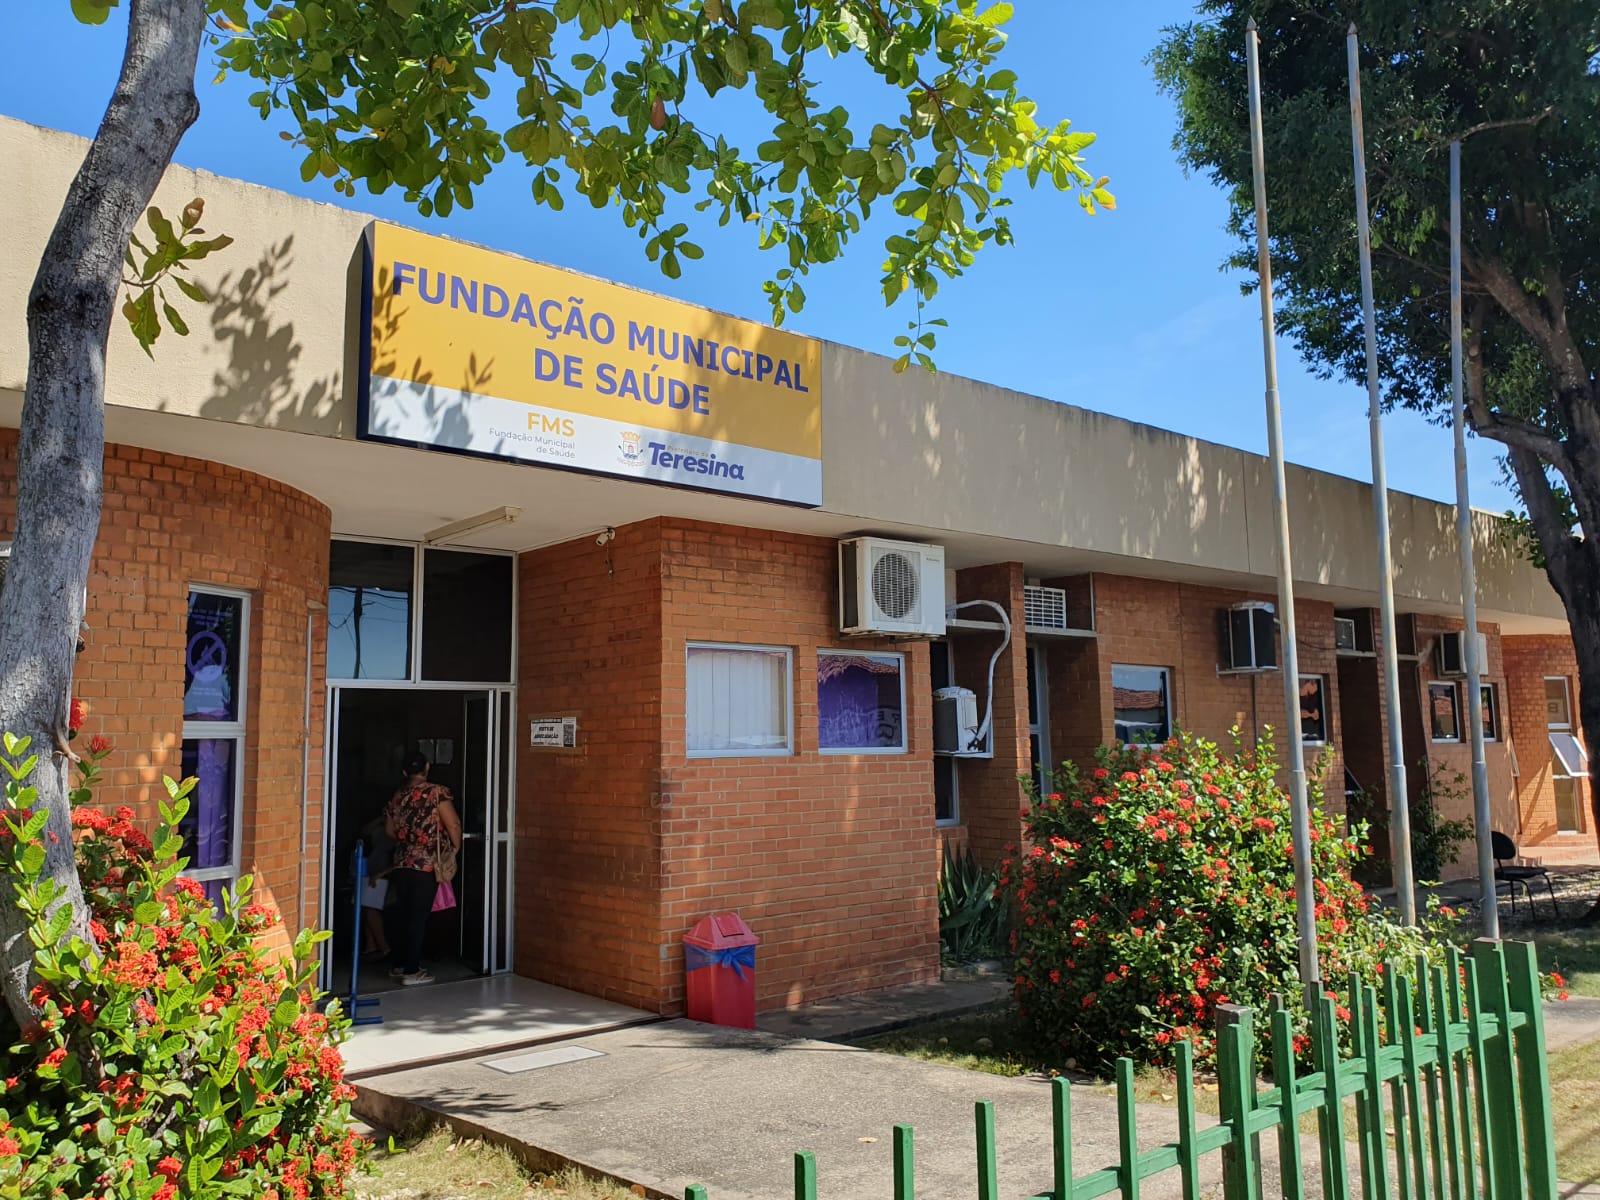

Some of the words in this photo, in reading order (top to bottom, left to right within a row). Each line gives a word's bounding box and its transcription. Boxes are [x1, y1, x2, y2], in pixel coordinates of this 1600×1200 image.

[392, 261, 616, 345] FUNDAÇÃO
[629, 321, 809, 393] MUNICIPAL
[535, 348, 583, 388] DE
[596, 363, 710, 415] SAÚDE
[489, 427, 533, 442] Fundação
[534, 436, 576, 449] Municipal
[527, 412, 575, 438] FMS
[536, 446, 548, 454] de
[648, 441, 744, 481] Teresina
